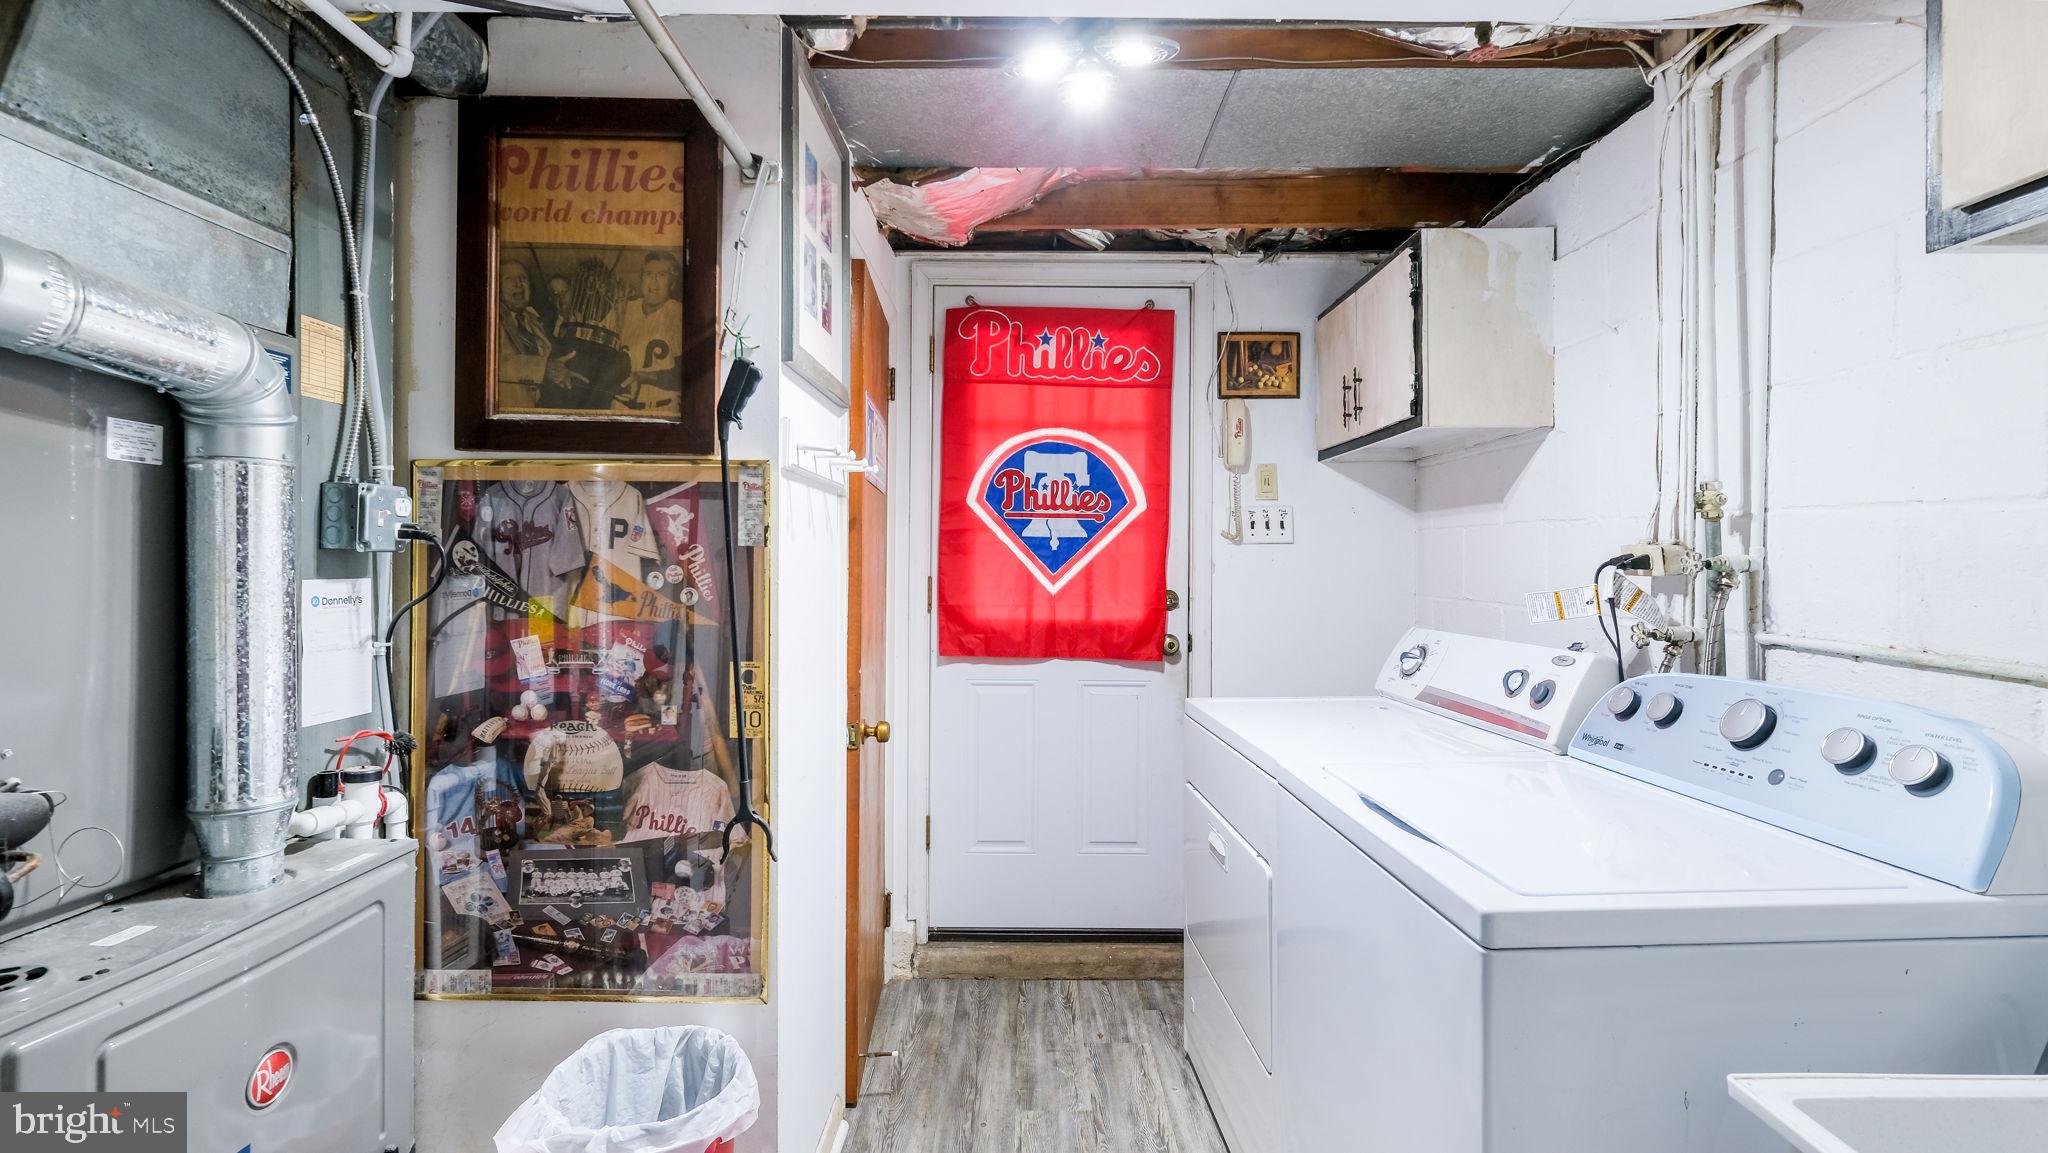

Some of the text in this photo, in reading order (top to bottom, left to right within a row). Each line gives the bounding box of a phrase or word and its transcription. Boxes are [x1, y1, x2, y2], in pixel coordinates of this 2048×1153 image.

[500, 145, 684, 193] Phillies
[958, 309, 1161, 382] Phillies
[994, 468, 1111, 513] Phillies
[608, 518, 629, 549] P
[678, 543, 714, 602] Phillies
[321, 595, 363, 607] Donnelly's
[1582, 732, 1611, 747] Whirlpool
[1925, 732, 1964, 744] WATER LEVEL
[446, 815, 477, 839] 14
